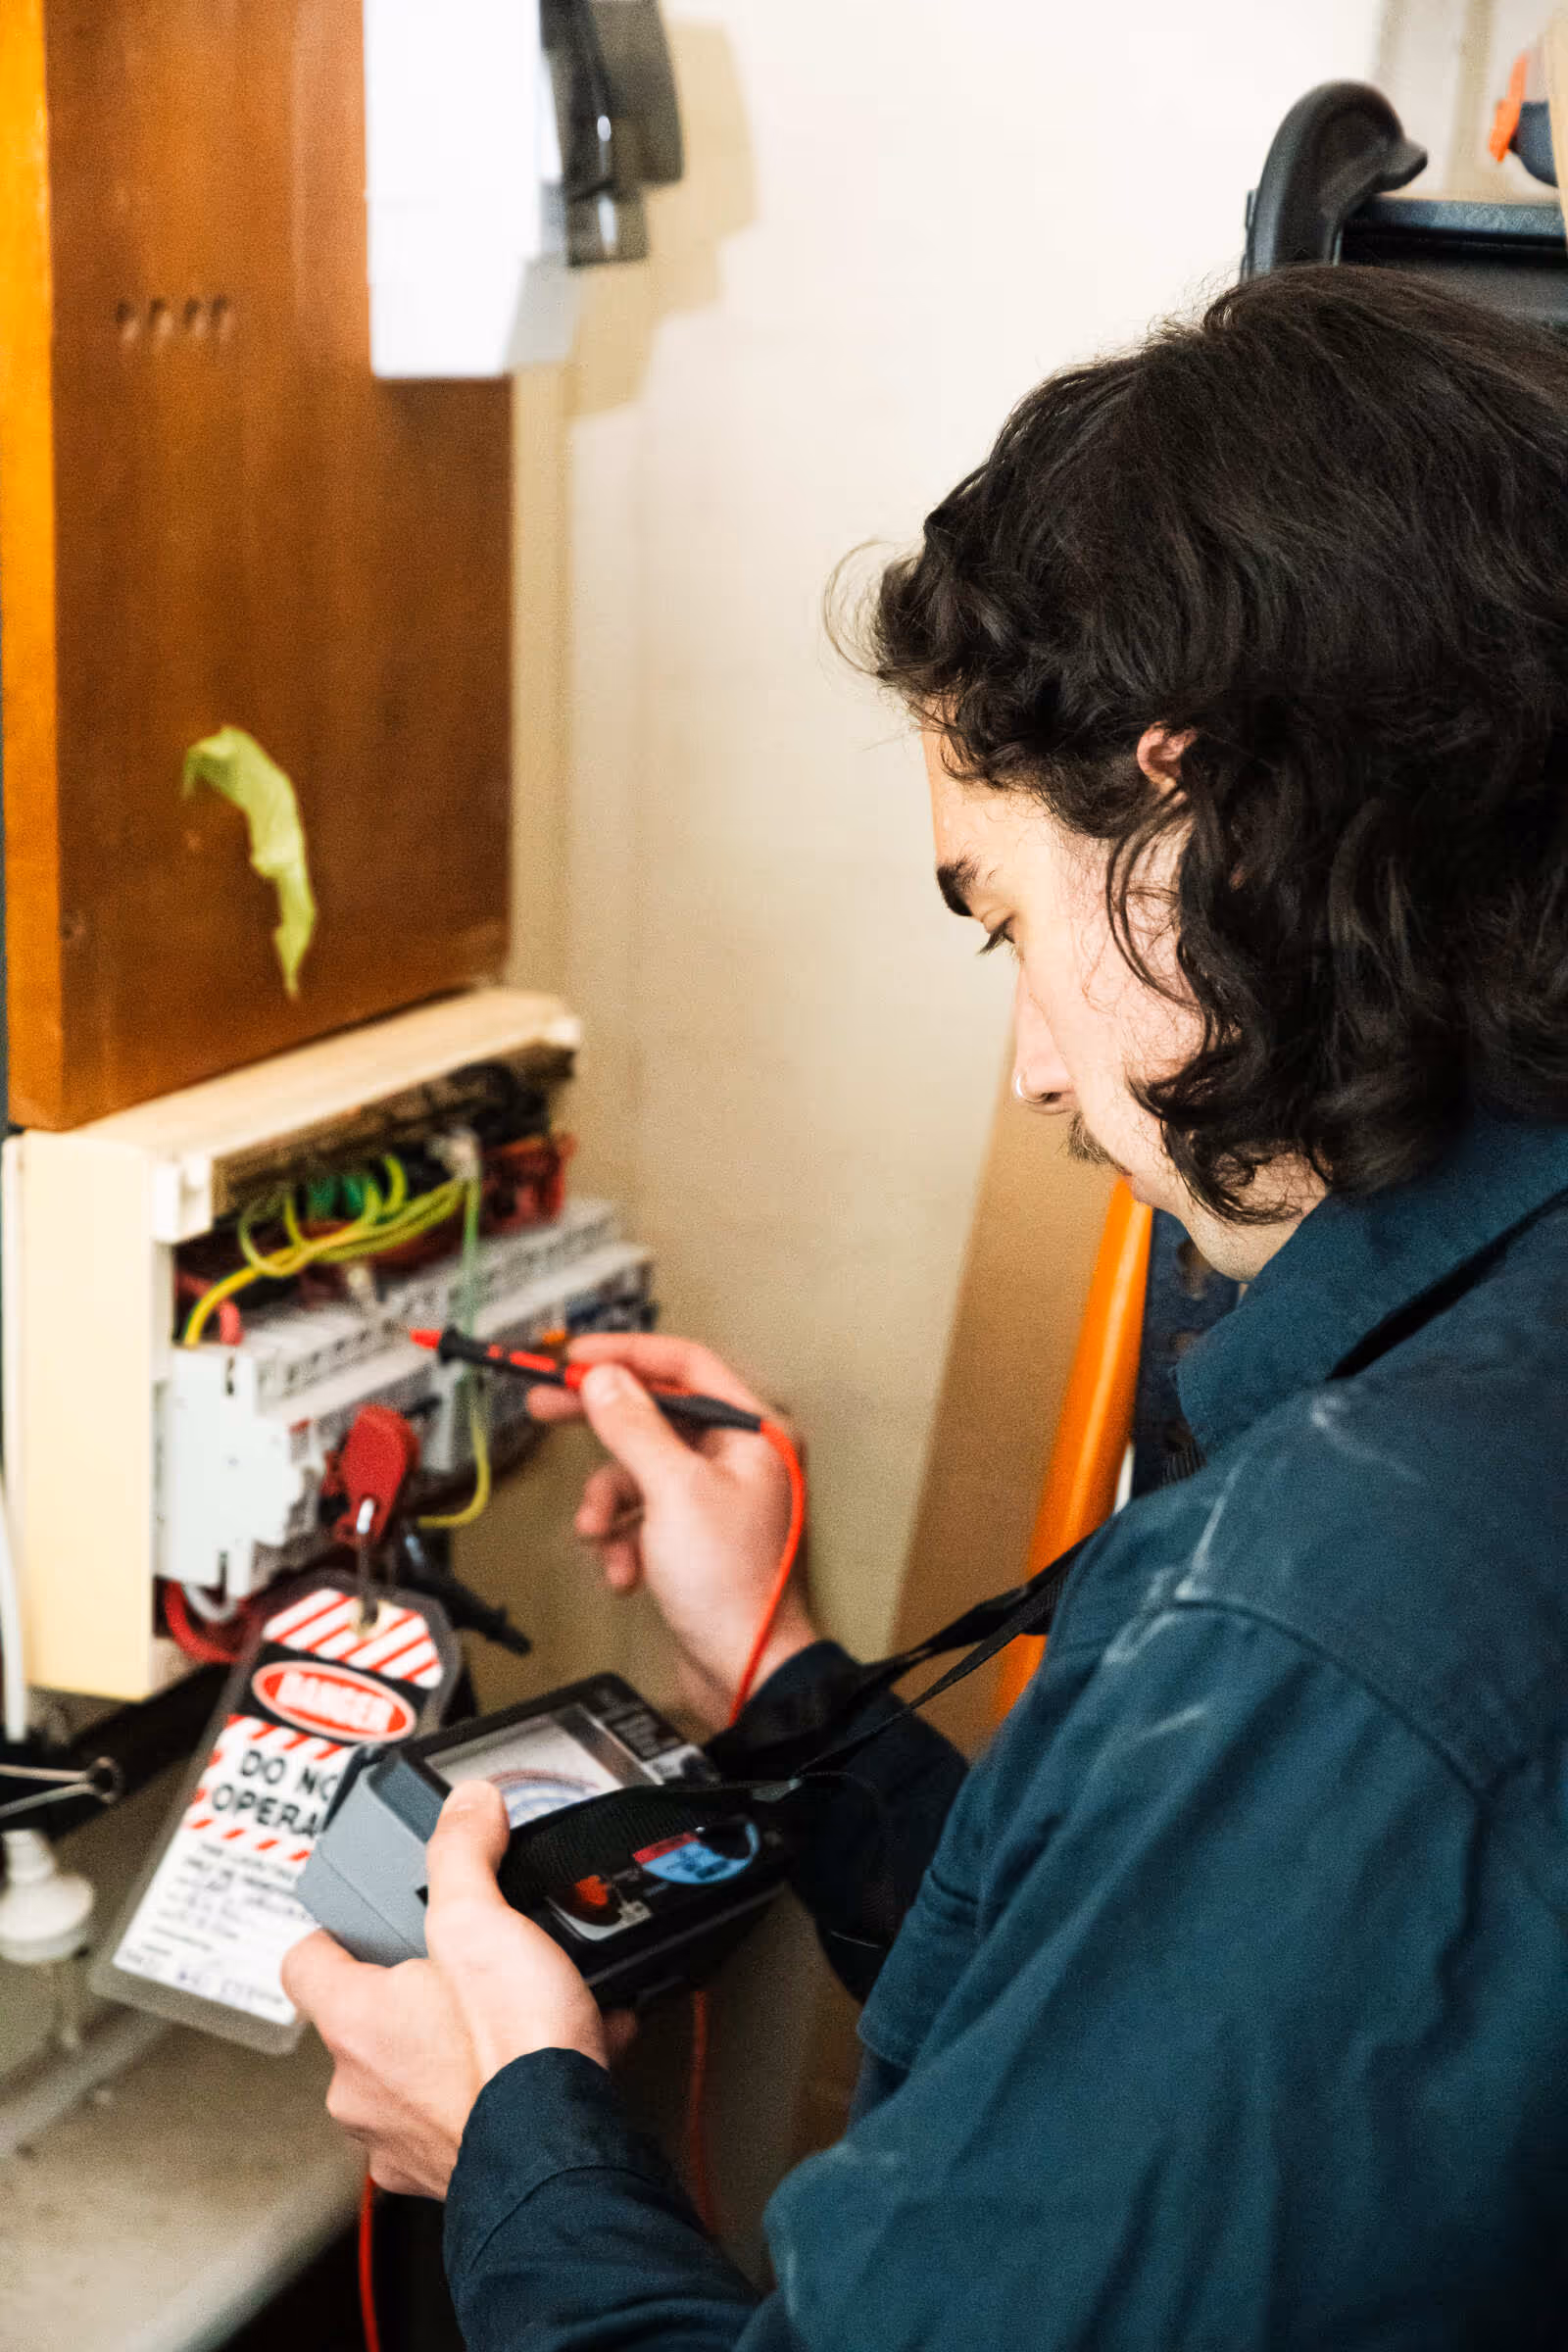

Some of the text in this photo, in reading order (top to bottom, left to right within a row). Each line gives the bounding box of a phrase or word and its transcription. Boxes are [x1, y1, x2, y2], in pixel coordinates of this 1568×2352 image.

[241, 1749, 340, 1801] DO NO
[213, 1783, 318, 1839] OPERA
